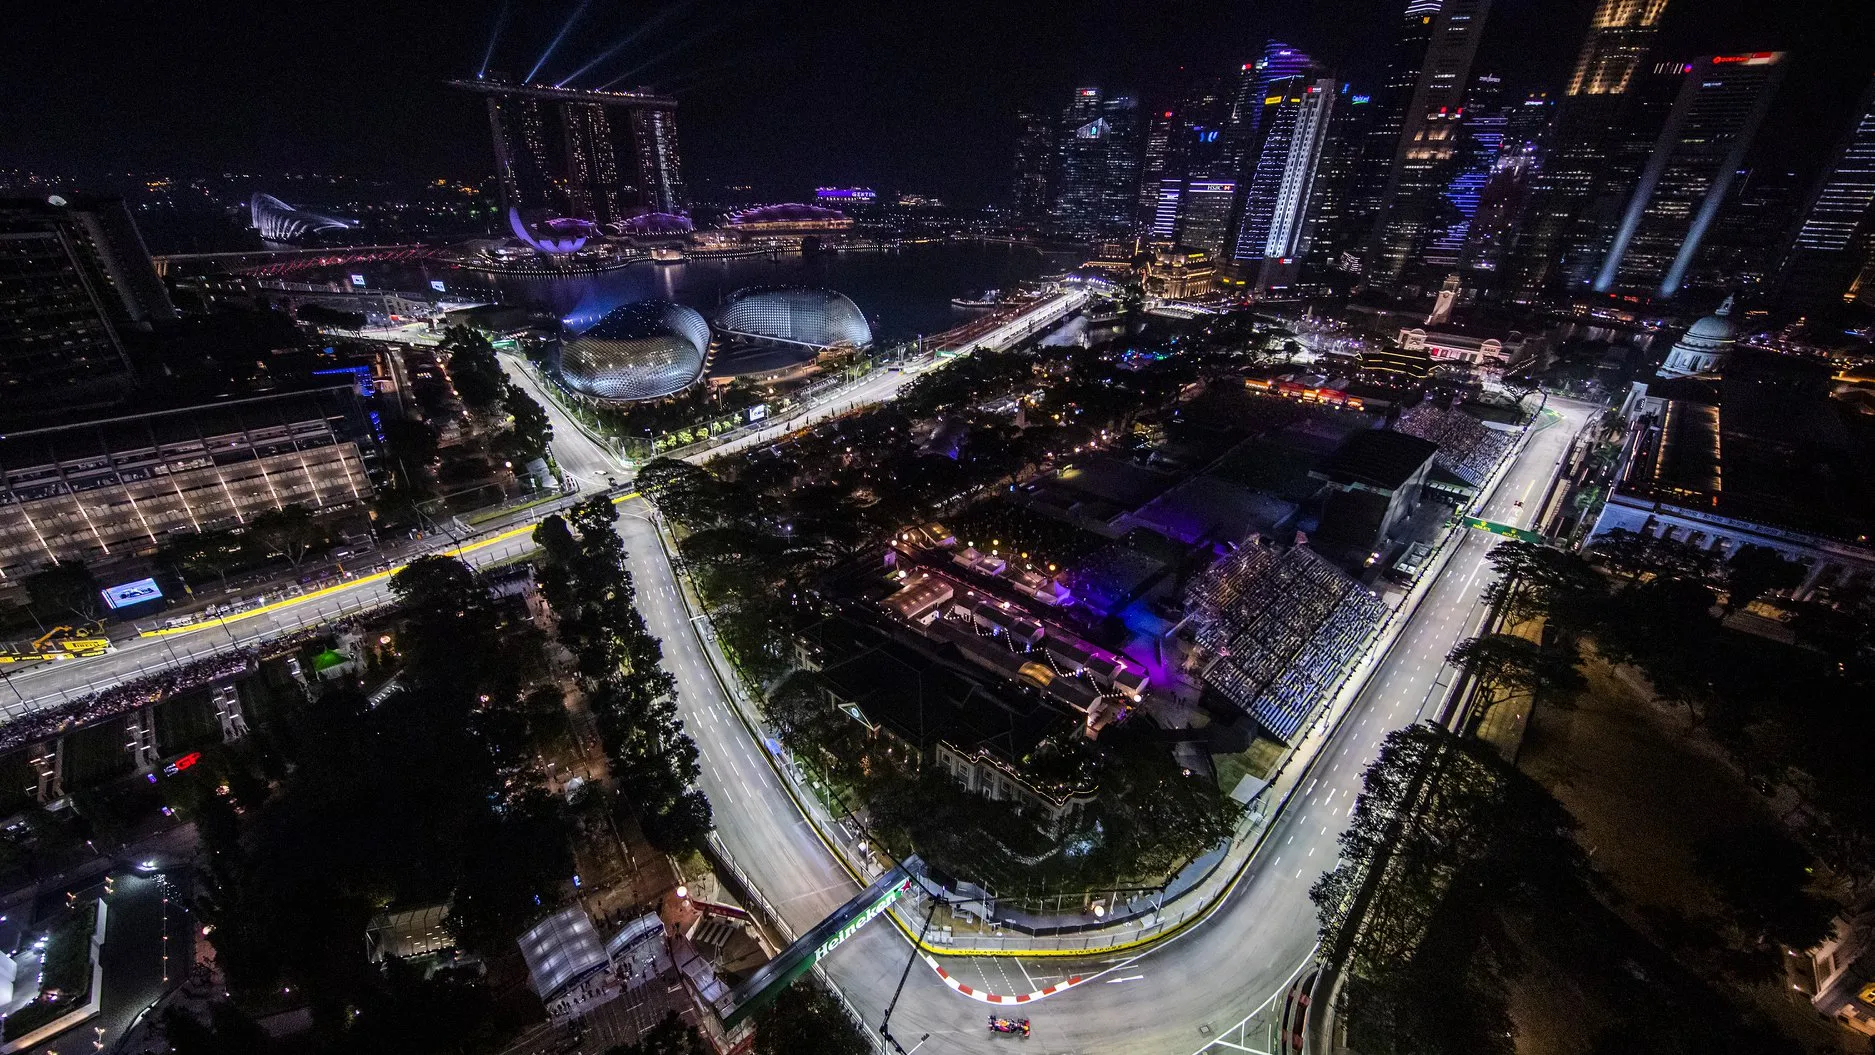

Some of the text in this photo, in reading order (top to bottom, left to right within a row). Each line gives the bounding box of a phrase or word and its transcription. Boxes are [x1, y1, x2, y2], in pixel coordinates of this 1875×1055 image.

[1473, 523, 1491, 532] ROLEX
[1502, 531, 1520, 539] ROLEX
[72, 641, 100, 649] PIRELLI
[814, 893, 897, 961] Heineken
[1069, 945, 1122, 954] SINGAPORE
